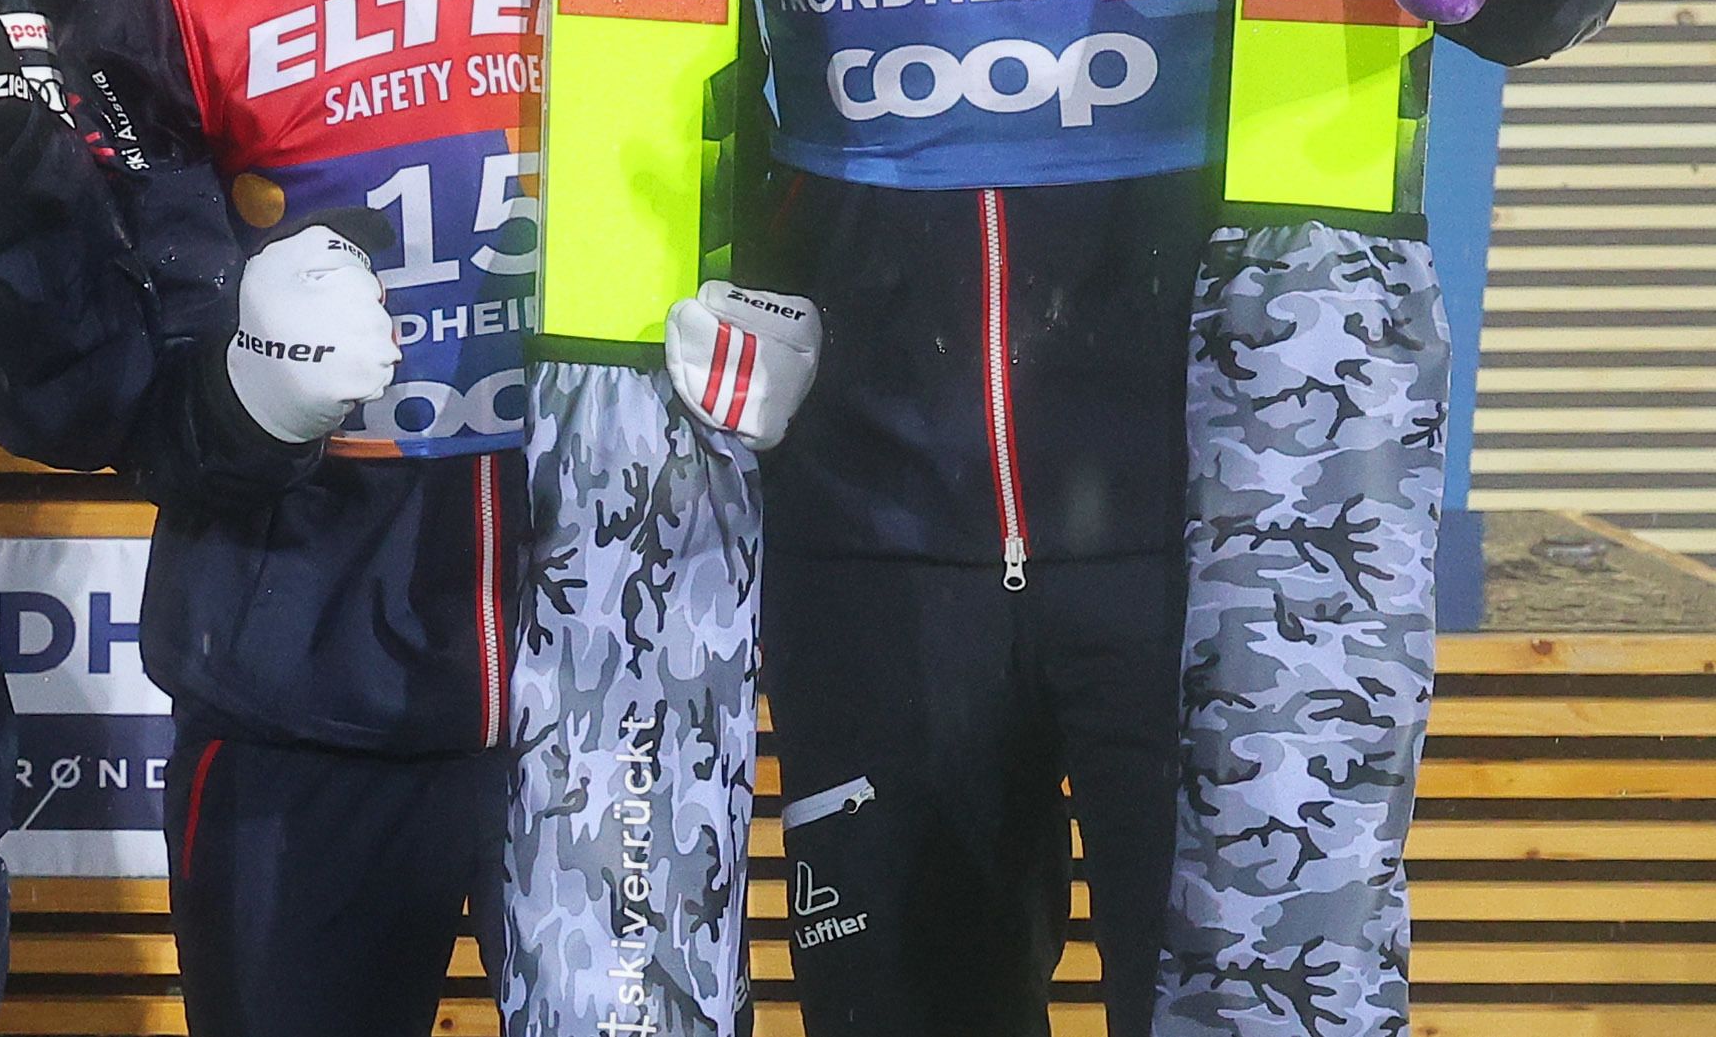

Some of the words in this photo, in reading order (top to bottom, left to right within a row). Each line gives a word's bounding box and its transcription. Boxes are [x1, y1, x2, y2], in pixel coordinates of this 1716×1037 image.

[325, 60, 453, 126] SAFETY
[466, 54, 543, 97] SHOE
[826, 31, 1158, 128] coop
[91, 71, 138, 142] Austria
[121, 147, 151, 171] Ski
[367, 151, 539, 291] 15
[727, 289, 807, 322] ziener
[237, 330, 335, 364] ziener
[795, 913, 868, 949] Löffler
